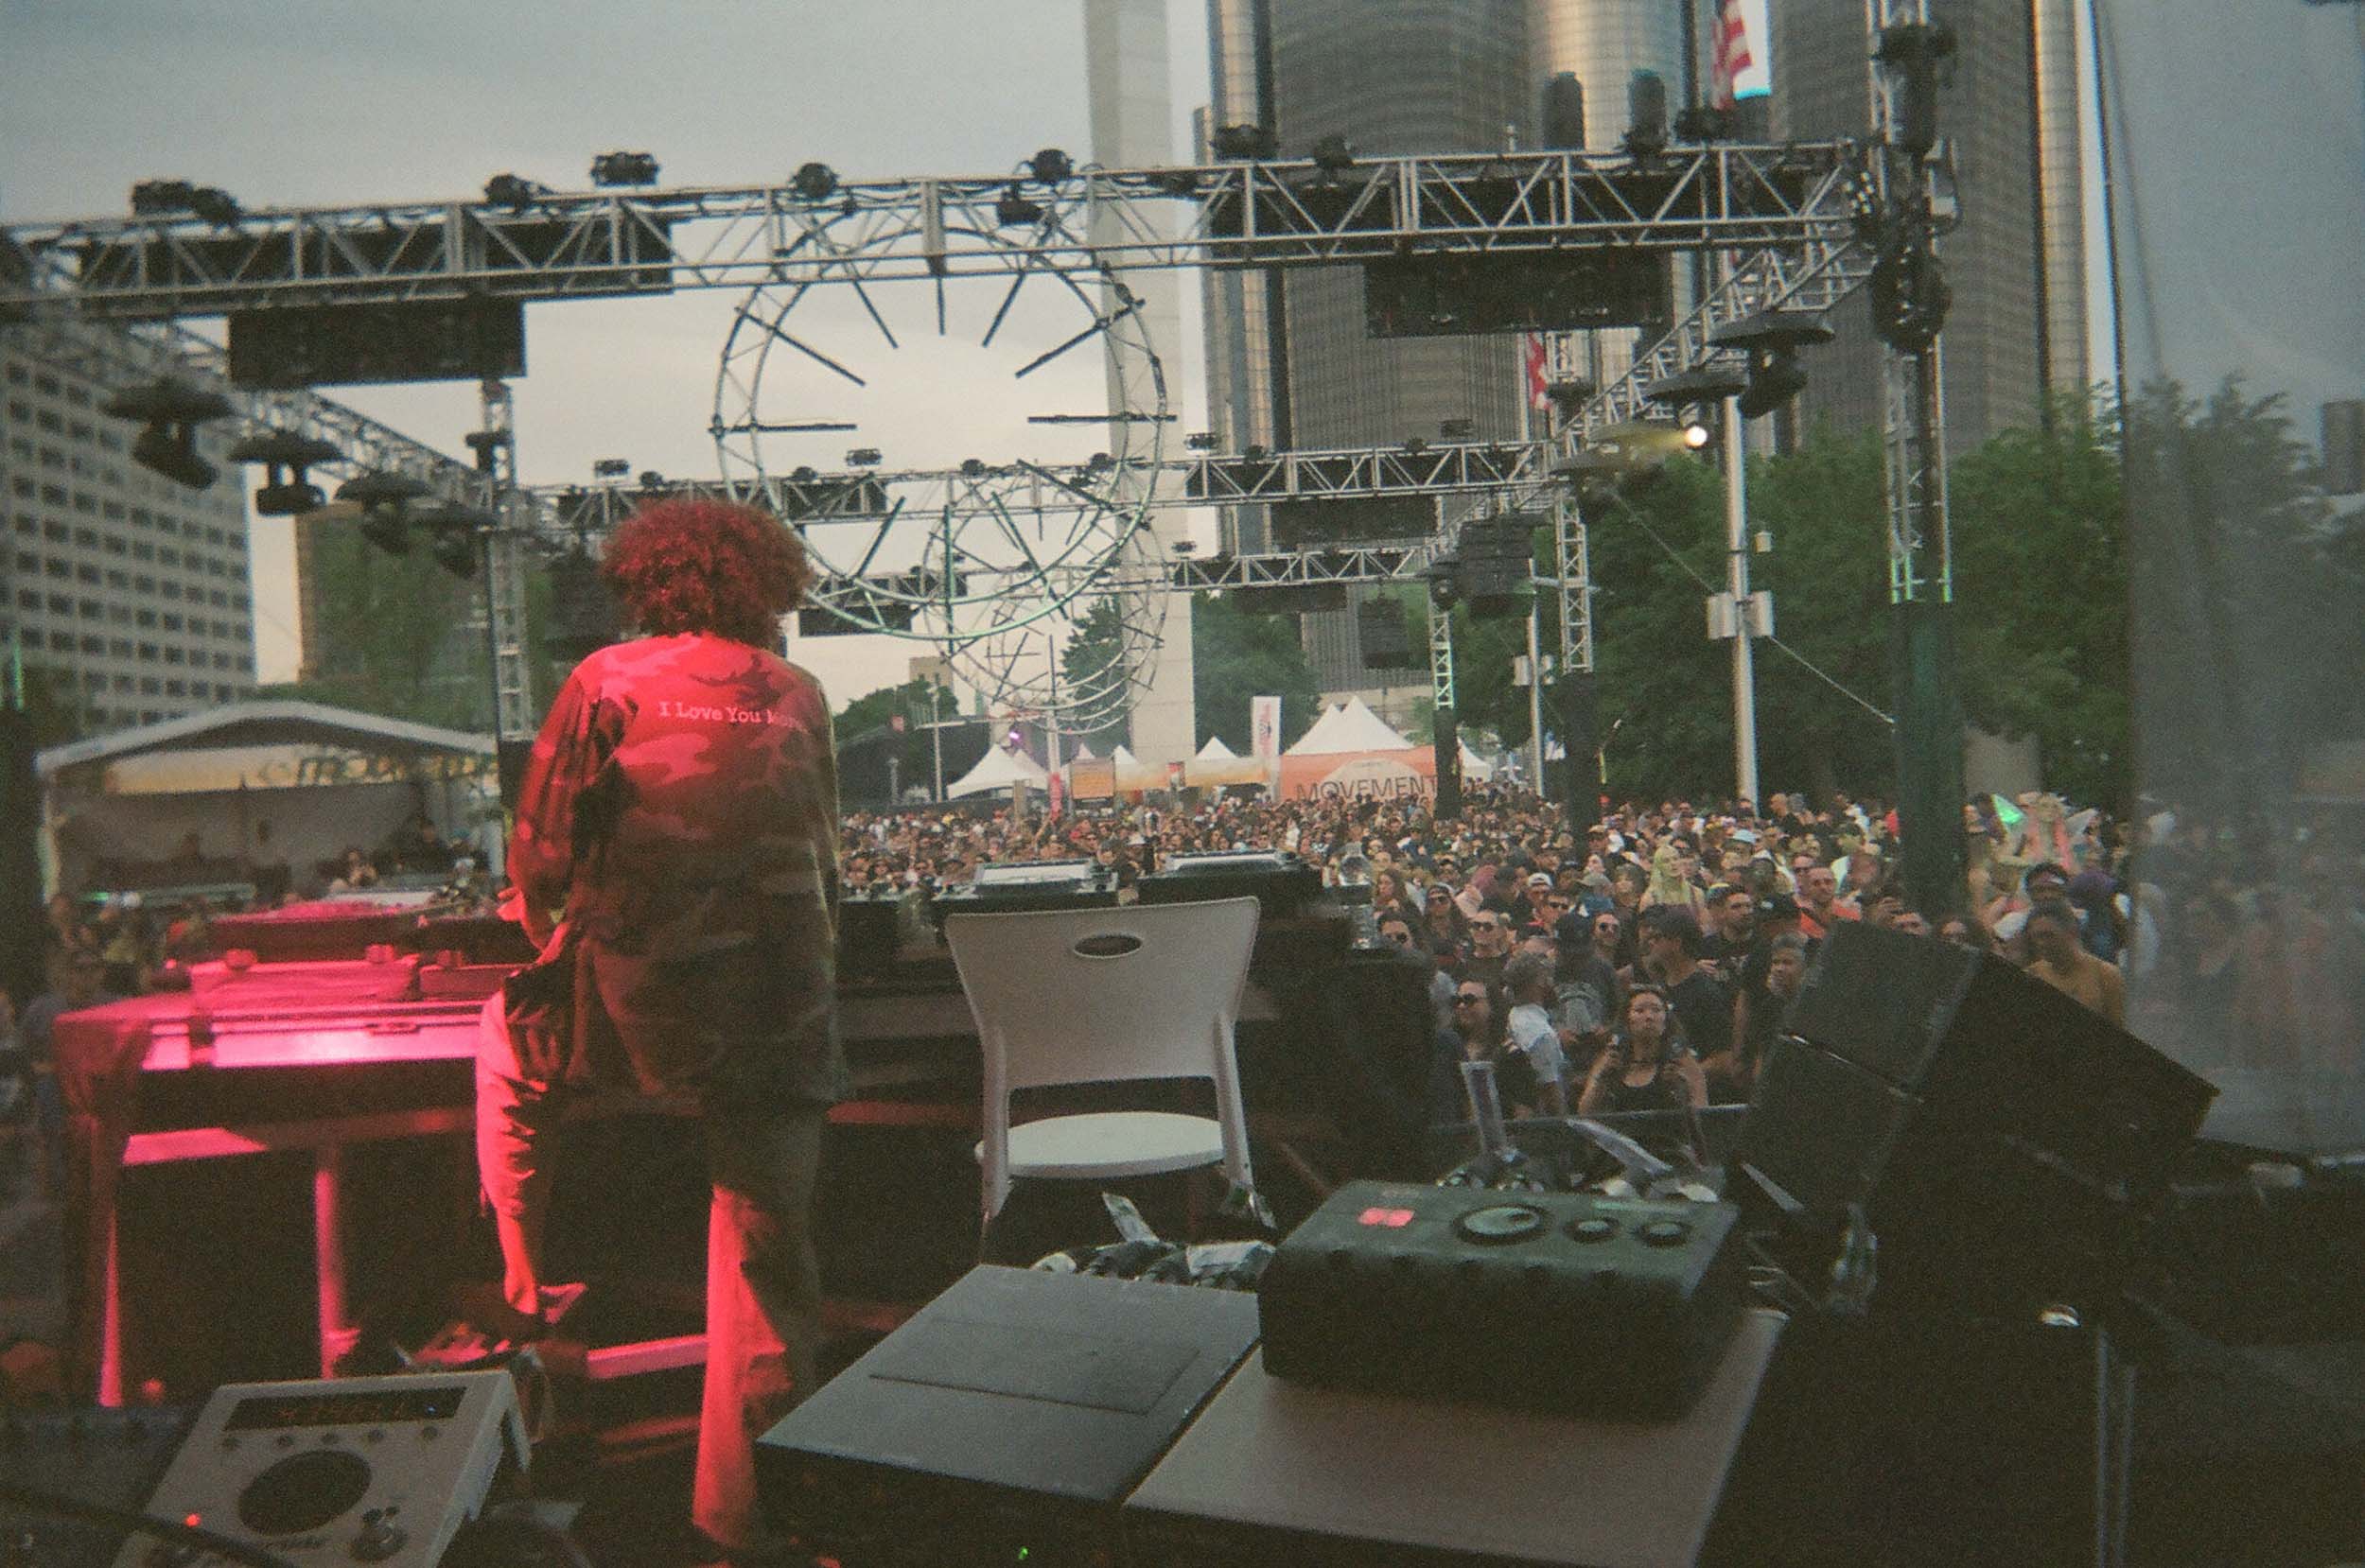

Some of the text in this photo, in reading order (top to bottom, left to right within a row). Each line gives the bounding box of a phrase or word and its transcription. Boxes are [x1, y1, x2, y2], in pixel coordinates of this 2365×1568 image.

[659, 701, 671, 718] I
[675, 702, 723, 721] Love
[726, 706, 762, 723] You
[1297, 775, 1438, 802] MOVEMENT
